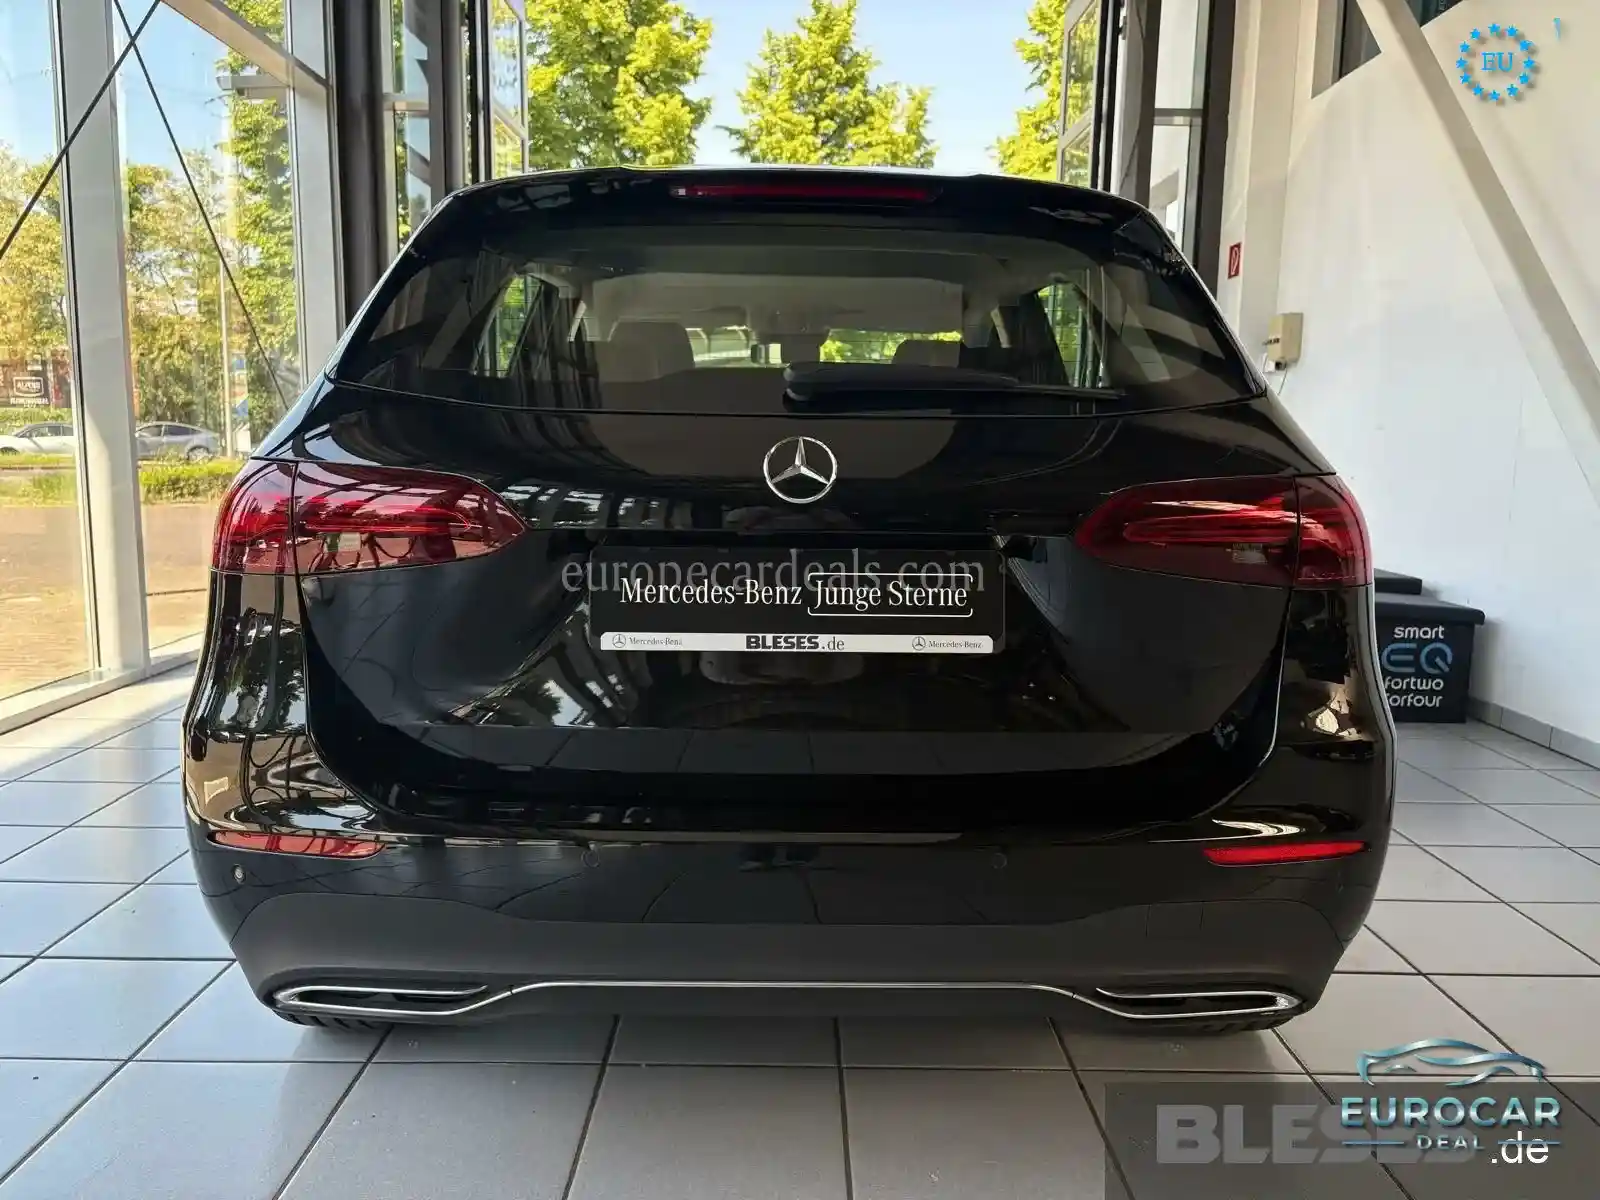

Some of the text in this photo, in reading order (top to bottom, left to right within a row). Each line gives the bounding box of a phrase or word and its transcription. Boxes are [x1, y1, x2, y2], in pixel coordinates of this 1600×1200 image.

[620, 577, 967, 612] Mercedes-Benz Junge Sterne
[1394, 625, 1444, 639] smart
[928, 640, 983, 650] Mercedes-Benz
[1385, 676, 1444, 690] fortwo
